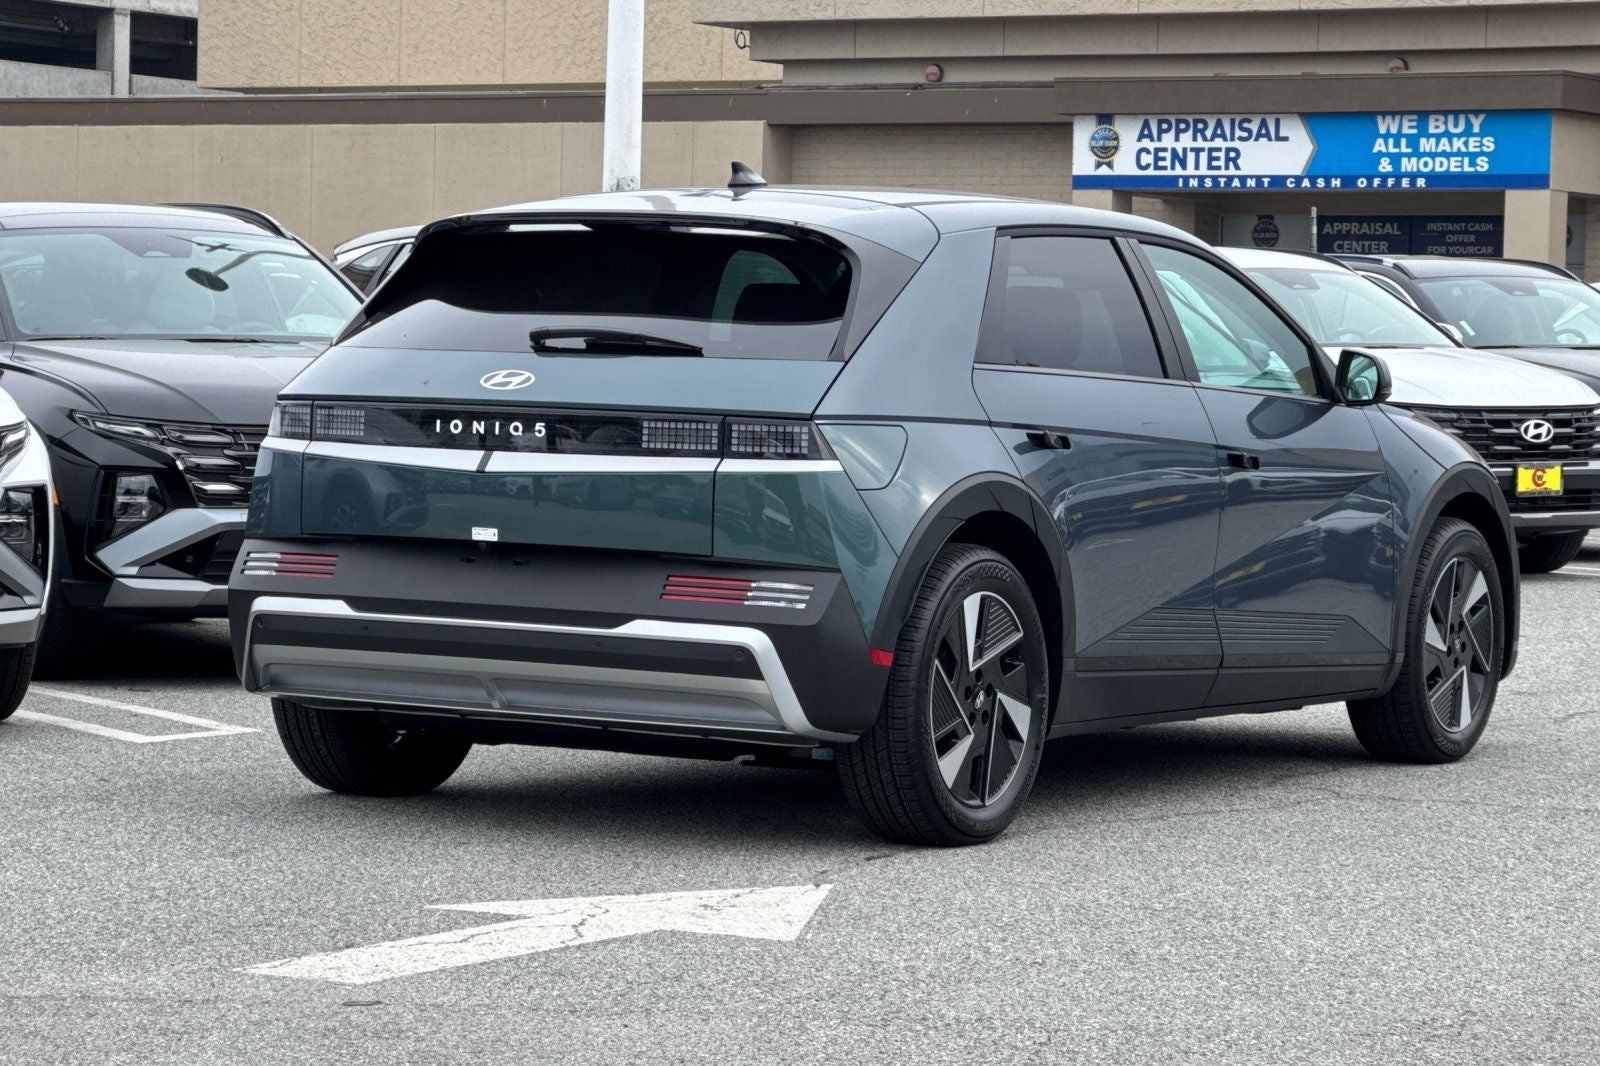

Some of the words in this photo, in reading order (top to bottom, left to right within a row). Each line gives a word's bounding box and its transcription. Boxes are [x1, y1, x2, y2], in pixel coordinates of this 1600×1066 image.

[1136, 118, 1289, 142] APPRAISAL
[1376, 114, 1418, 133] WE
[1428, 114, 1486, 134] BUY
[1372, 138, 1412, 153] ALL
[1419, 136, 1495, 152] MAKES
[1135, 146, 1242, 171] CENTER
[1378, 157, 1393, 172] &
[1401, 156, 1489, 172] MODELS
[1178, 177, 1271, 188] INSTANT
[1286, 177, 1341, 188] CASH
[1357, 177, 1427, 188] OFFER
[1322, 222, 1401, 235] APPRAISAL
[1427, 222, 1466, 232] INSTANT
[1468, 222, 1493, 232] CASH
[1446, 234, 1476, 243] OFFER
[1333, 240, 1389, 253] CENTER
[1428, 246, 1447, 255] FOR
[435, 418, 523, 436] IONIQ
[534, 422, 546, 437] 5
